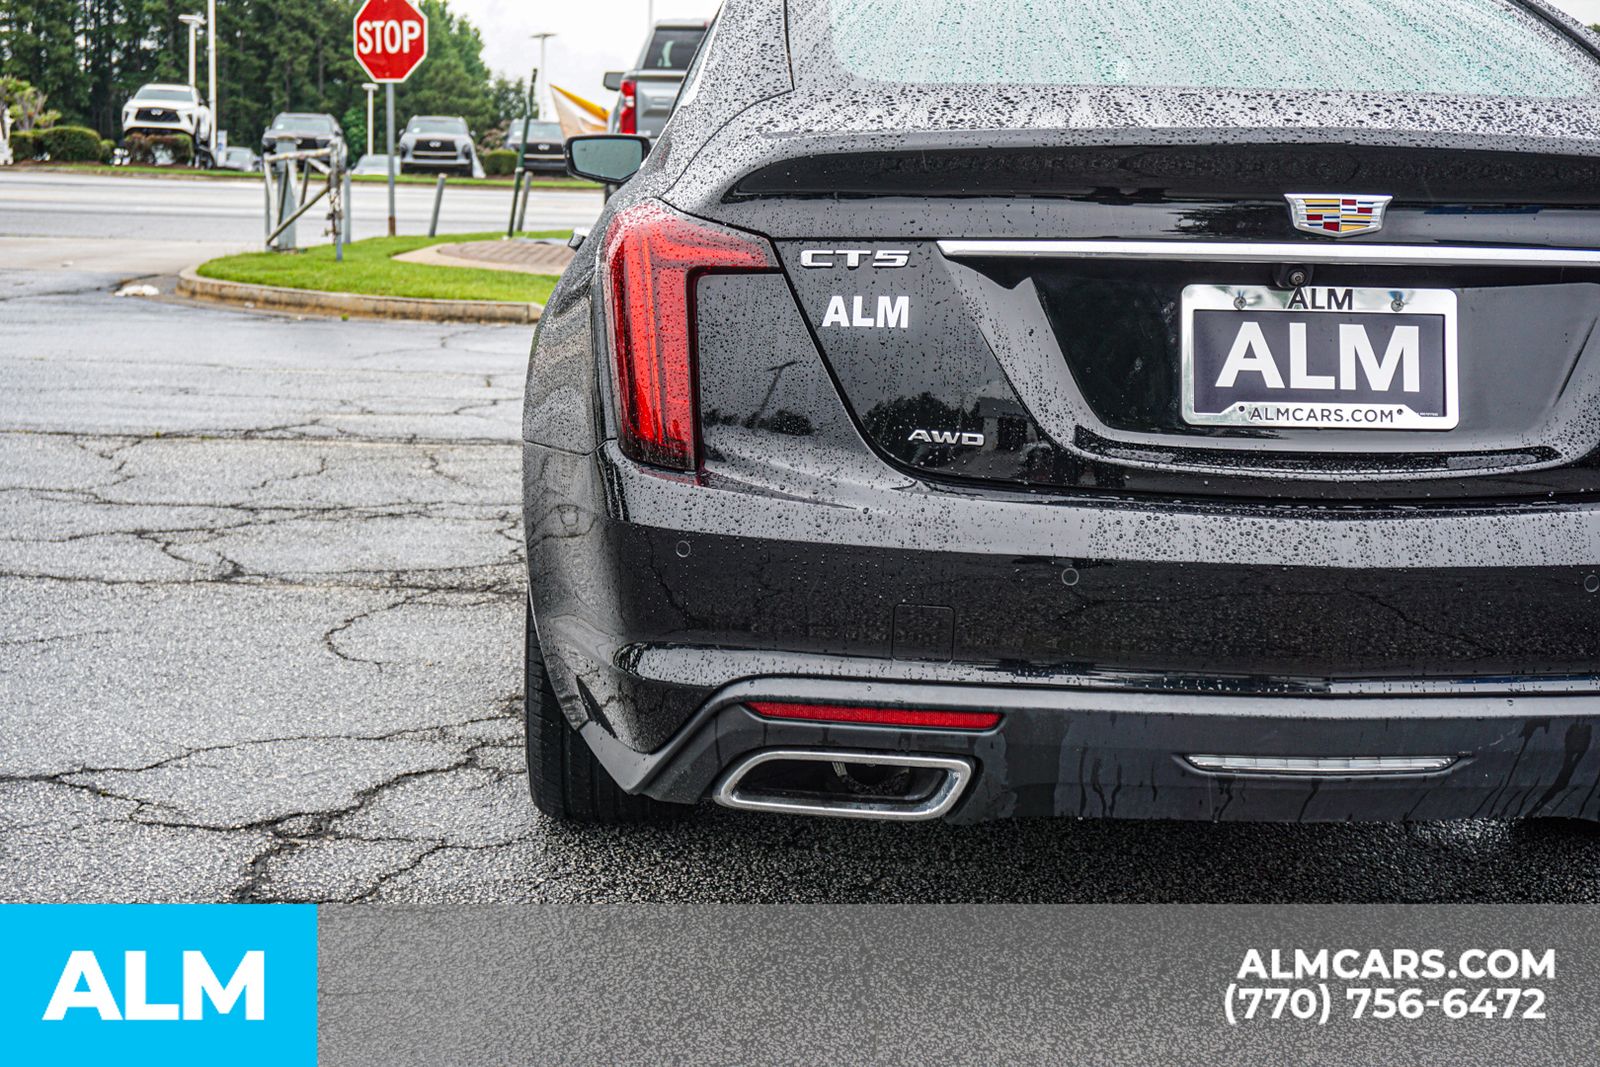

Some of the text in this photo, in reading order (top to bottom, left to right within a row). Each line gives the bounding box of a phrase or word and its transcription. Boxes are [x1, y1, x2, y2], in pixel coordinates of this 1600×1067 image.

[358, 20, 422, 55] STOP
[800, 249, 910, 269] CT5
[1287, 287, 1354, 311] ALM
[821, 295, 910, 329] ALM
[1214, 321, 1420, 393] ALM
[1249, 406, 1394, 424] ALMCARS.COM
[908, 429, 985, 447] AWD
